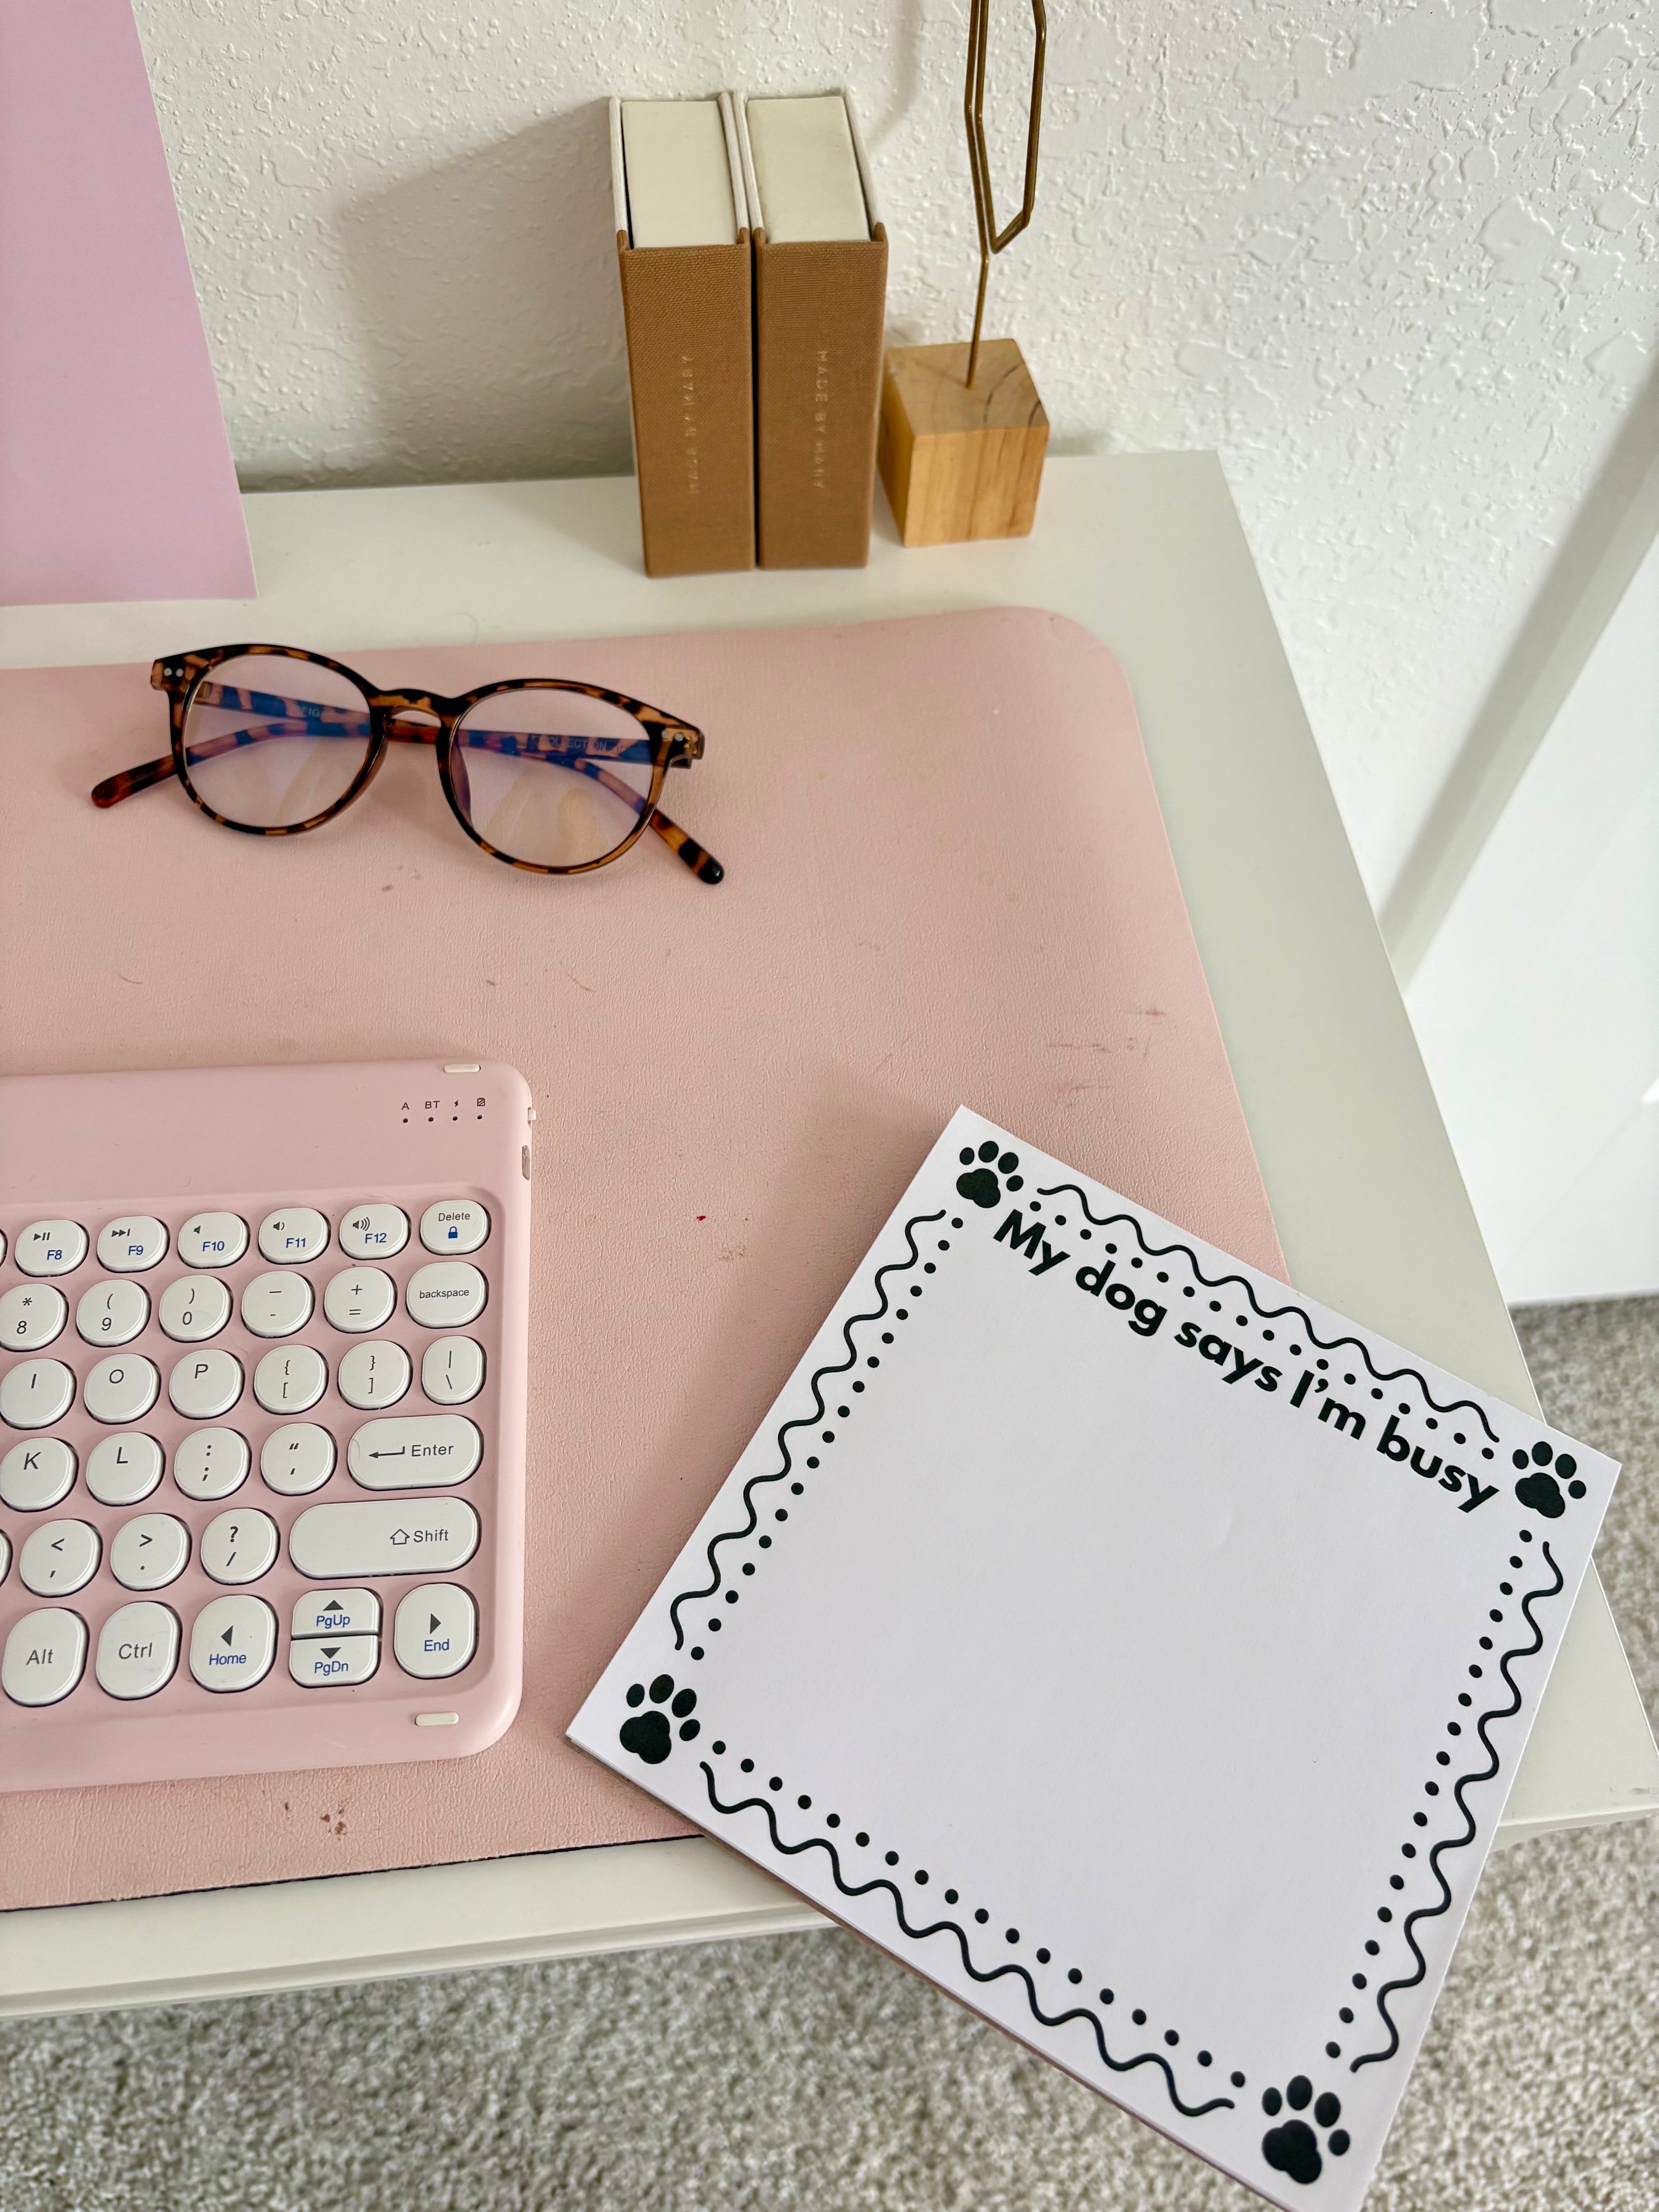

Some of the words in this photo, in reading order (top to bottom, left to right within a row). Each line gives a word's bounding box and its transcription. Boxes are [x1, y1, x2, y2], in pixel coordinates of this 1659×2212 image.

[815, 350, 828, 401] MADE
[401, 1102, 410, 1110] A
[425, 1100, 440, 1109] BT
[438, 1212, 470, 1221] Delete
[286, 1237, 306, 1248] F11
[364, 1232, 387, 1244] F12
[128, 1245, 143, 1256] F9
[202, 1241, 225, 1252] F10
[47, 1249, 62, 1260] F8
[189, 1288, 195, 1304] )
[351, 1284, 363, 1295] +
[419, 1289, 469, 1299] backspace
[107, 1294, 113, 1309] (
[102, 1317, 111, 1331] 9
[182, 1311, 192, 1325] 0
[16, 1320, 27, 1334] 8
[369, 1355, 376, 1371] }
[448, 1351, 452, 1369] |
[993, 1209, 1070, 1276] My
[1076, 1260, 1167, 1336] dog
[1174, 1322, 1282, 1392] says
[1290, 1370, 1366, 1440] I’m
[1377, 1415, 1499, 1513] busy
[194, 1364, 209, 1379] P
[284, 1360, 291, 1376] {
[31, 1373, 37, 1389] I
[109, 1369, 124, 1384] O
[445, 1374, 453, 1390] \
[283, 1382, 289, 1398] [
[368, 1377, 374, 1394] ]
[116, 1446, 128, 1464] L
[206, 1445, 212, 1456] :
[412, 1444, 454, 1457] Enter
[23, 1452, 41, 1470] K
[202, 1467, 209, 1481] ;
[139, 1534, 153, 1547] >
[230, 1526, 238, 1543] ?
[413, 1529, 449, 1543] Shift
[51, 1538, 65, 1551] <
[226, 1551, 237, 1567] /
[316, 1614, 350, 1629] PgUp
[118, 1642, 153, 1659] Ctrl
[424, 1638, 450, 1652] End
[26, 1649, 54, 1665] Alt
[209, 1653, 247, 1665] Home
[315, 1661, 349, 1676] PgDn
